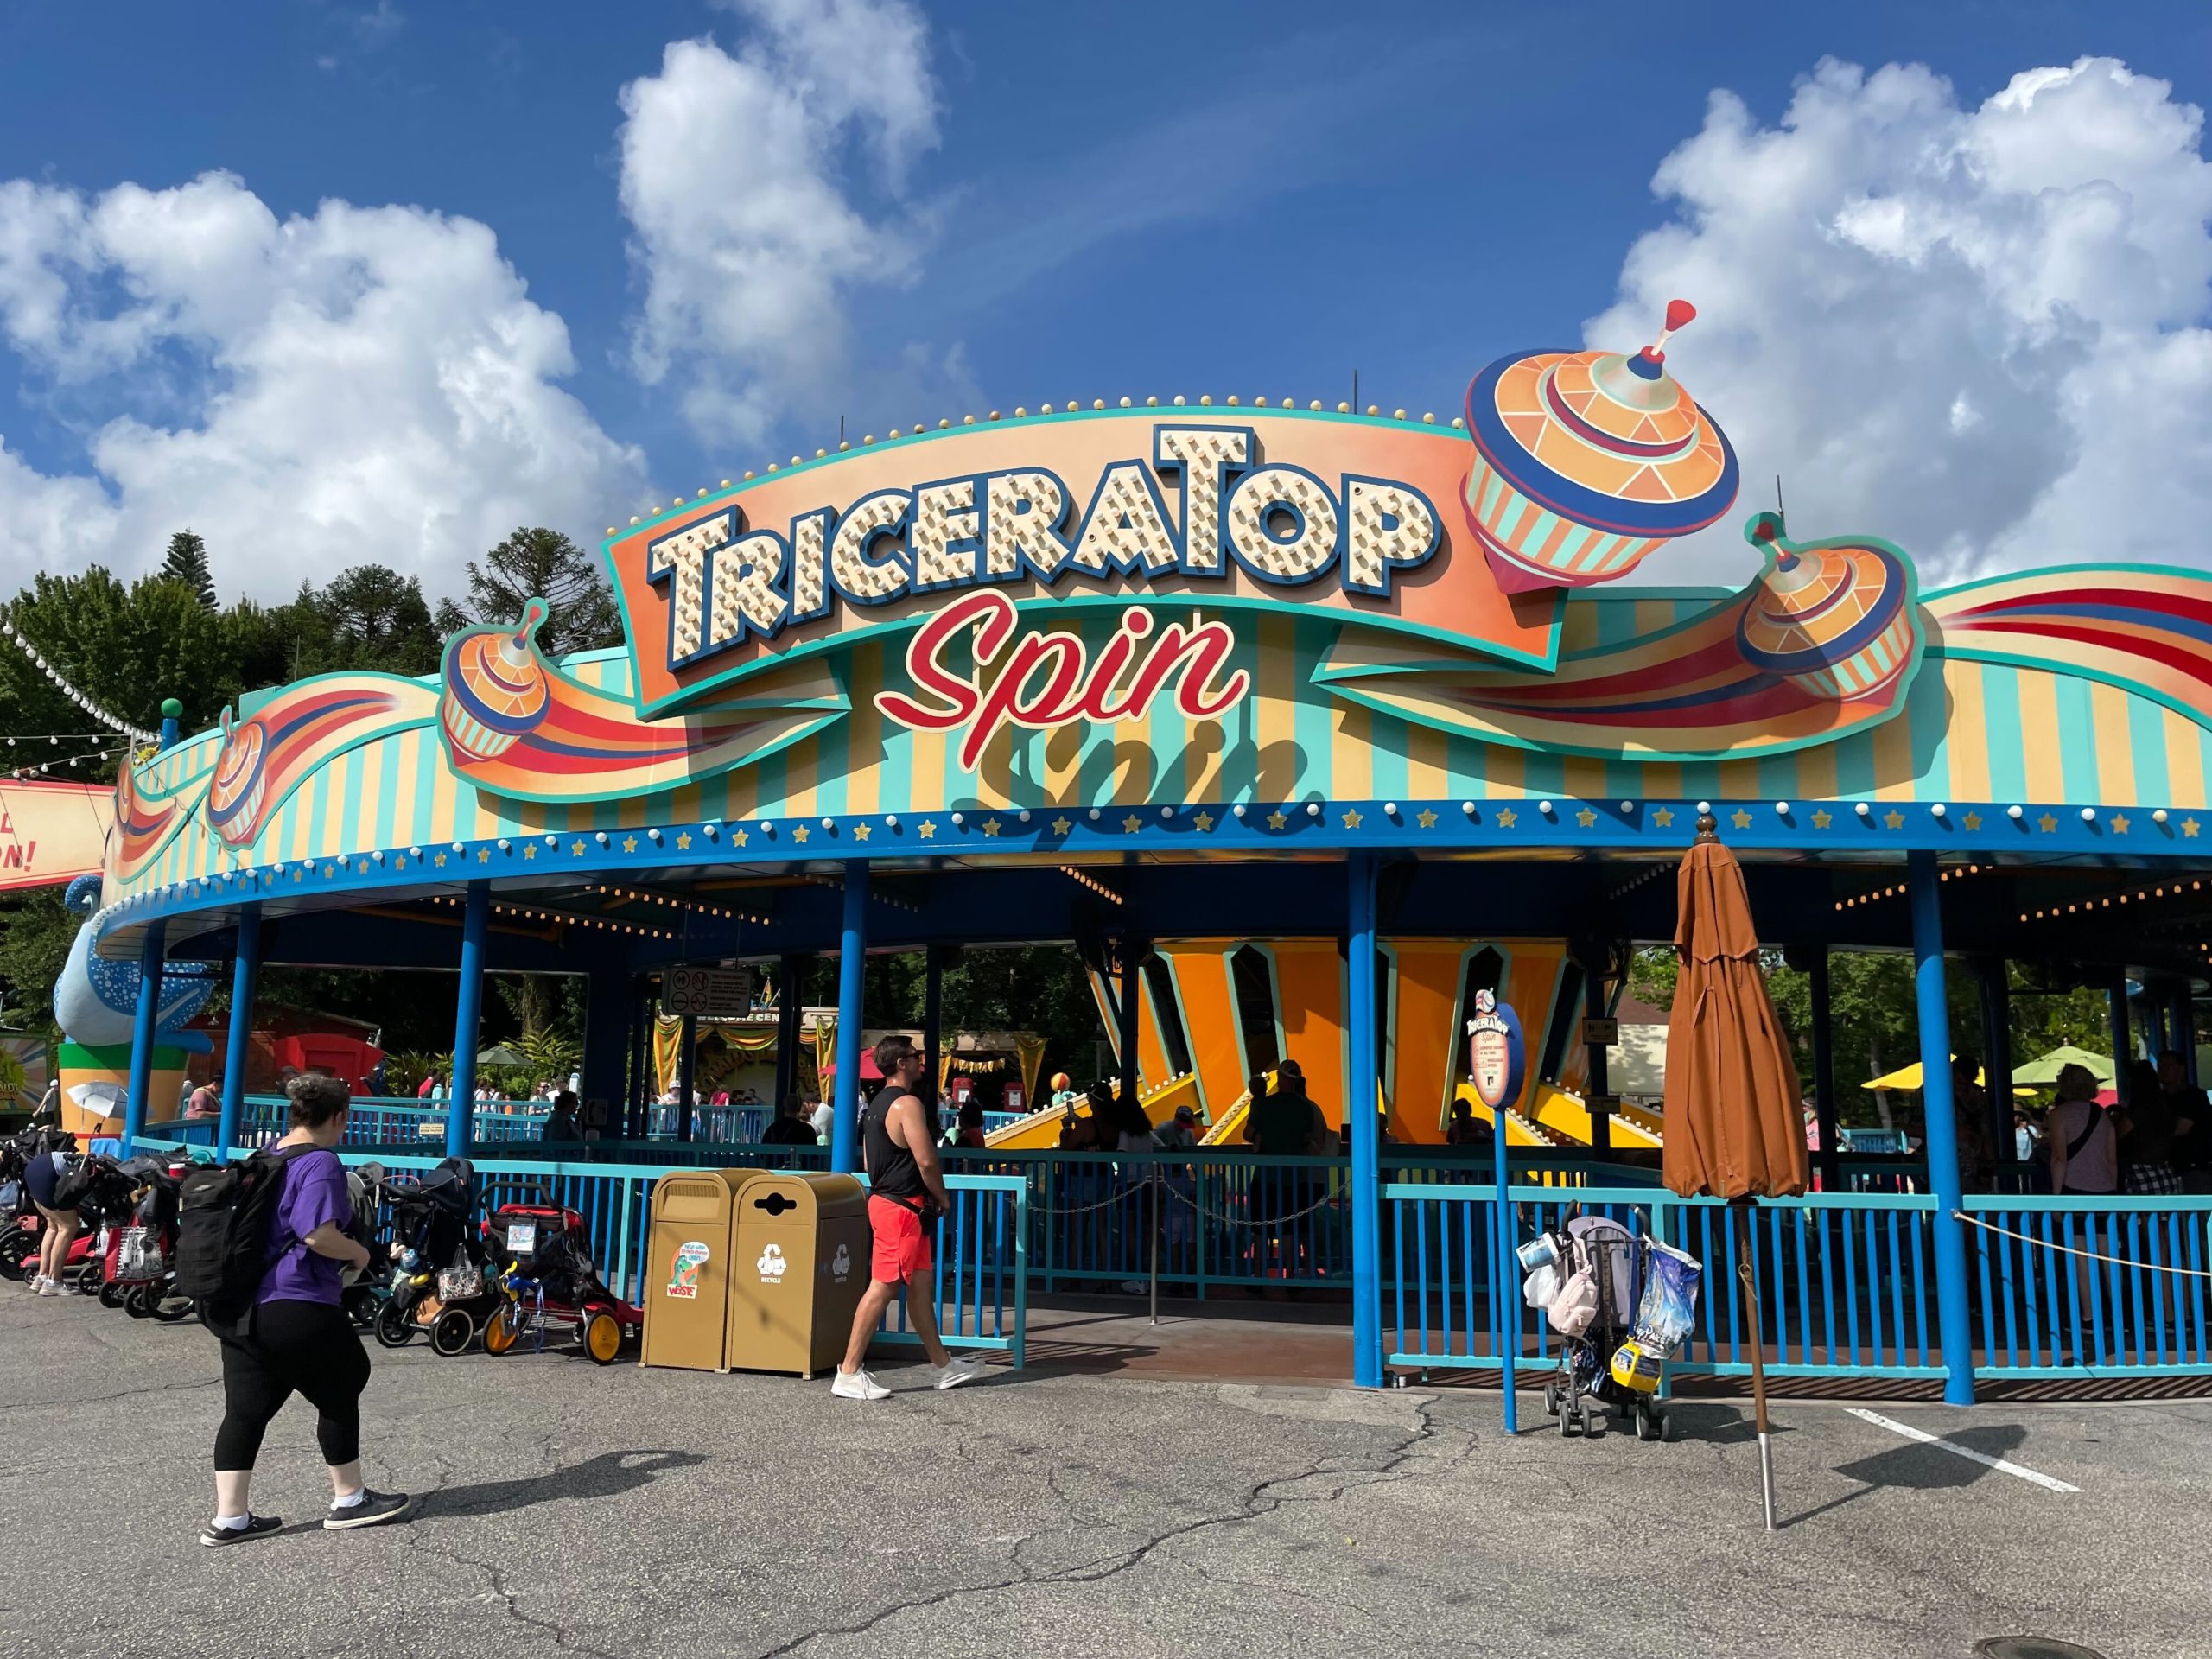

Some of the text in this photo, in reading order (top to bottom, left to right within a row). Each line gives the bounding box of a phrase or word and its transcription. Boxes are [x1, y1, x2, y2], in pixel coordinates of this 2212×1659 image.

[648, 424, 1441, 671] TRICERATOP
[874, 588, 1250, 773] Spin
[0, 841, 36, 872] N!
[755, 1013, 779, 1022] CEN
